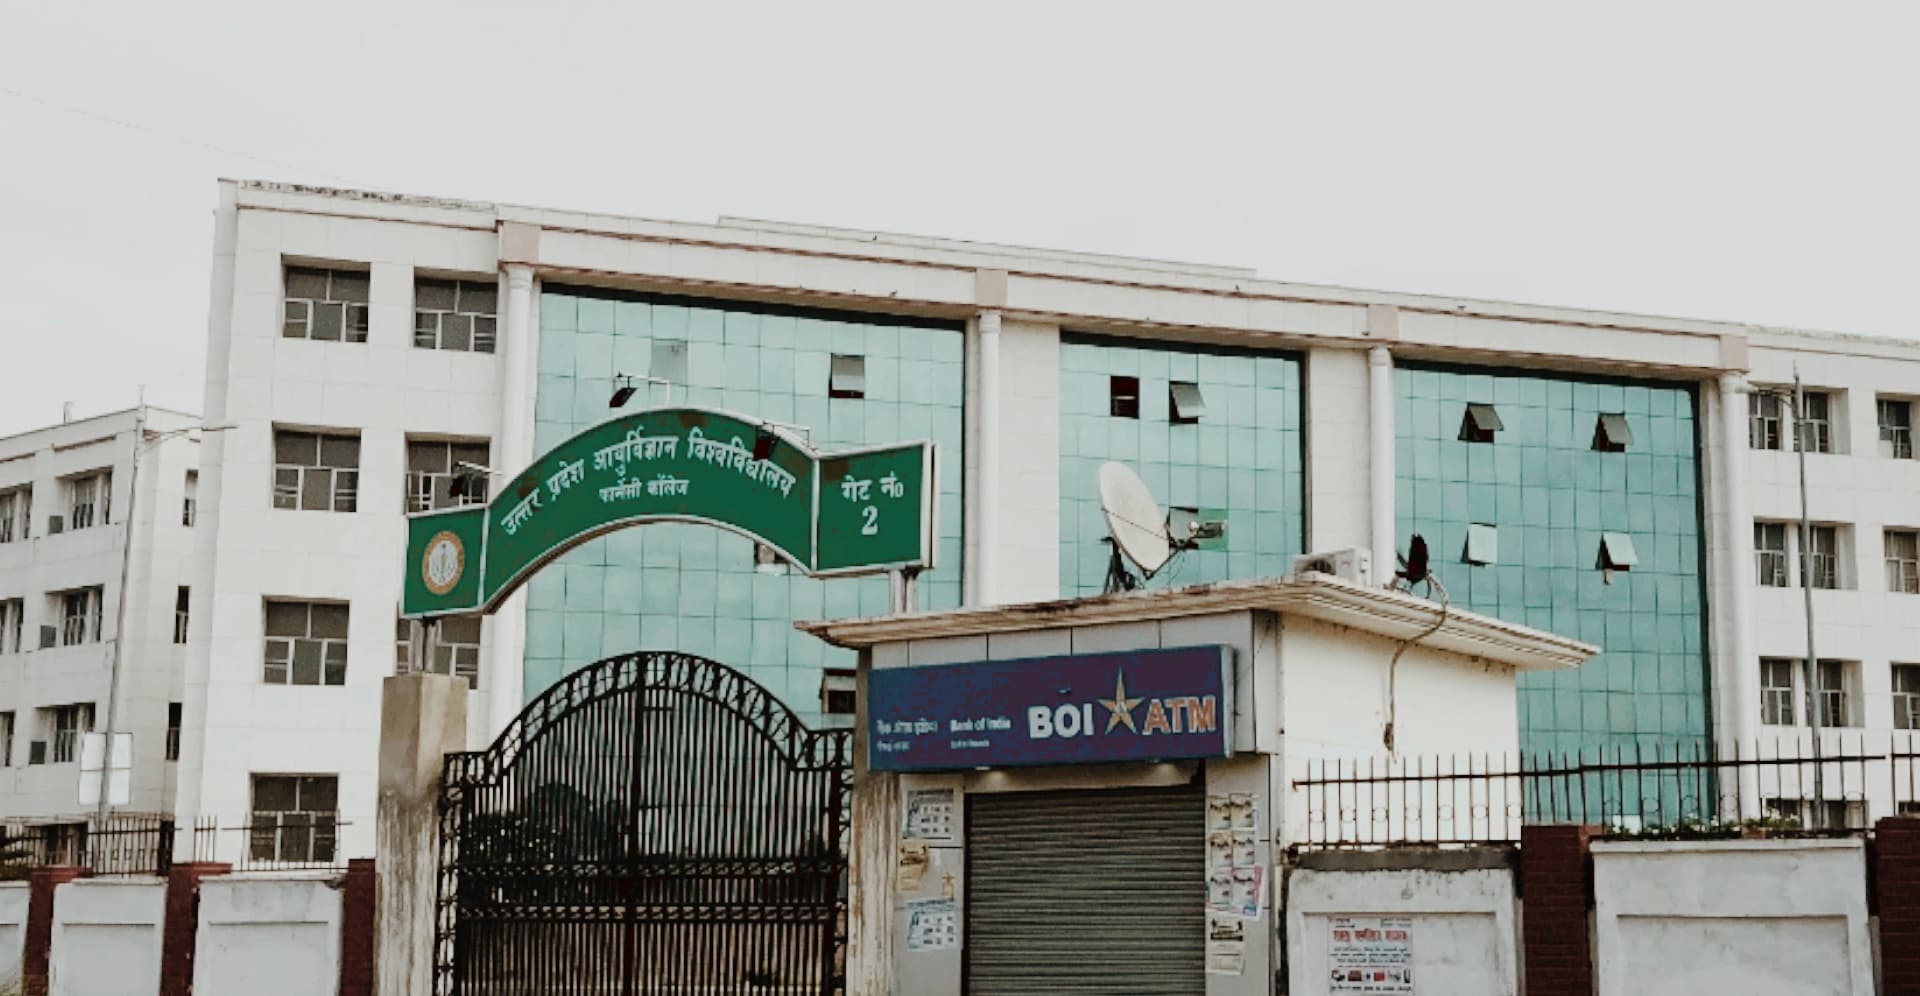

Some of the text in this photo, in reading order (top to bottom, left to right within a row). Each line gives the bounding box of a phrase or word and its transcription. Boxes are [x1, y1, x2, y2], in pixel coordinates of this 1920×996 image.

[501, 487, 545, 535] उत्तर
[546, 458, 585, 501] प्रदेश
[593, 425, 680, 476] आयुर्विज्ञान
[841, 474, 872, 503] गेट
[861, 505, 878, 535] 2
[1028, 695, 1216, 738] BOI ATM
